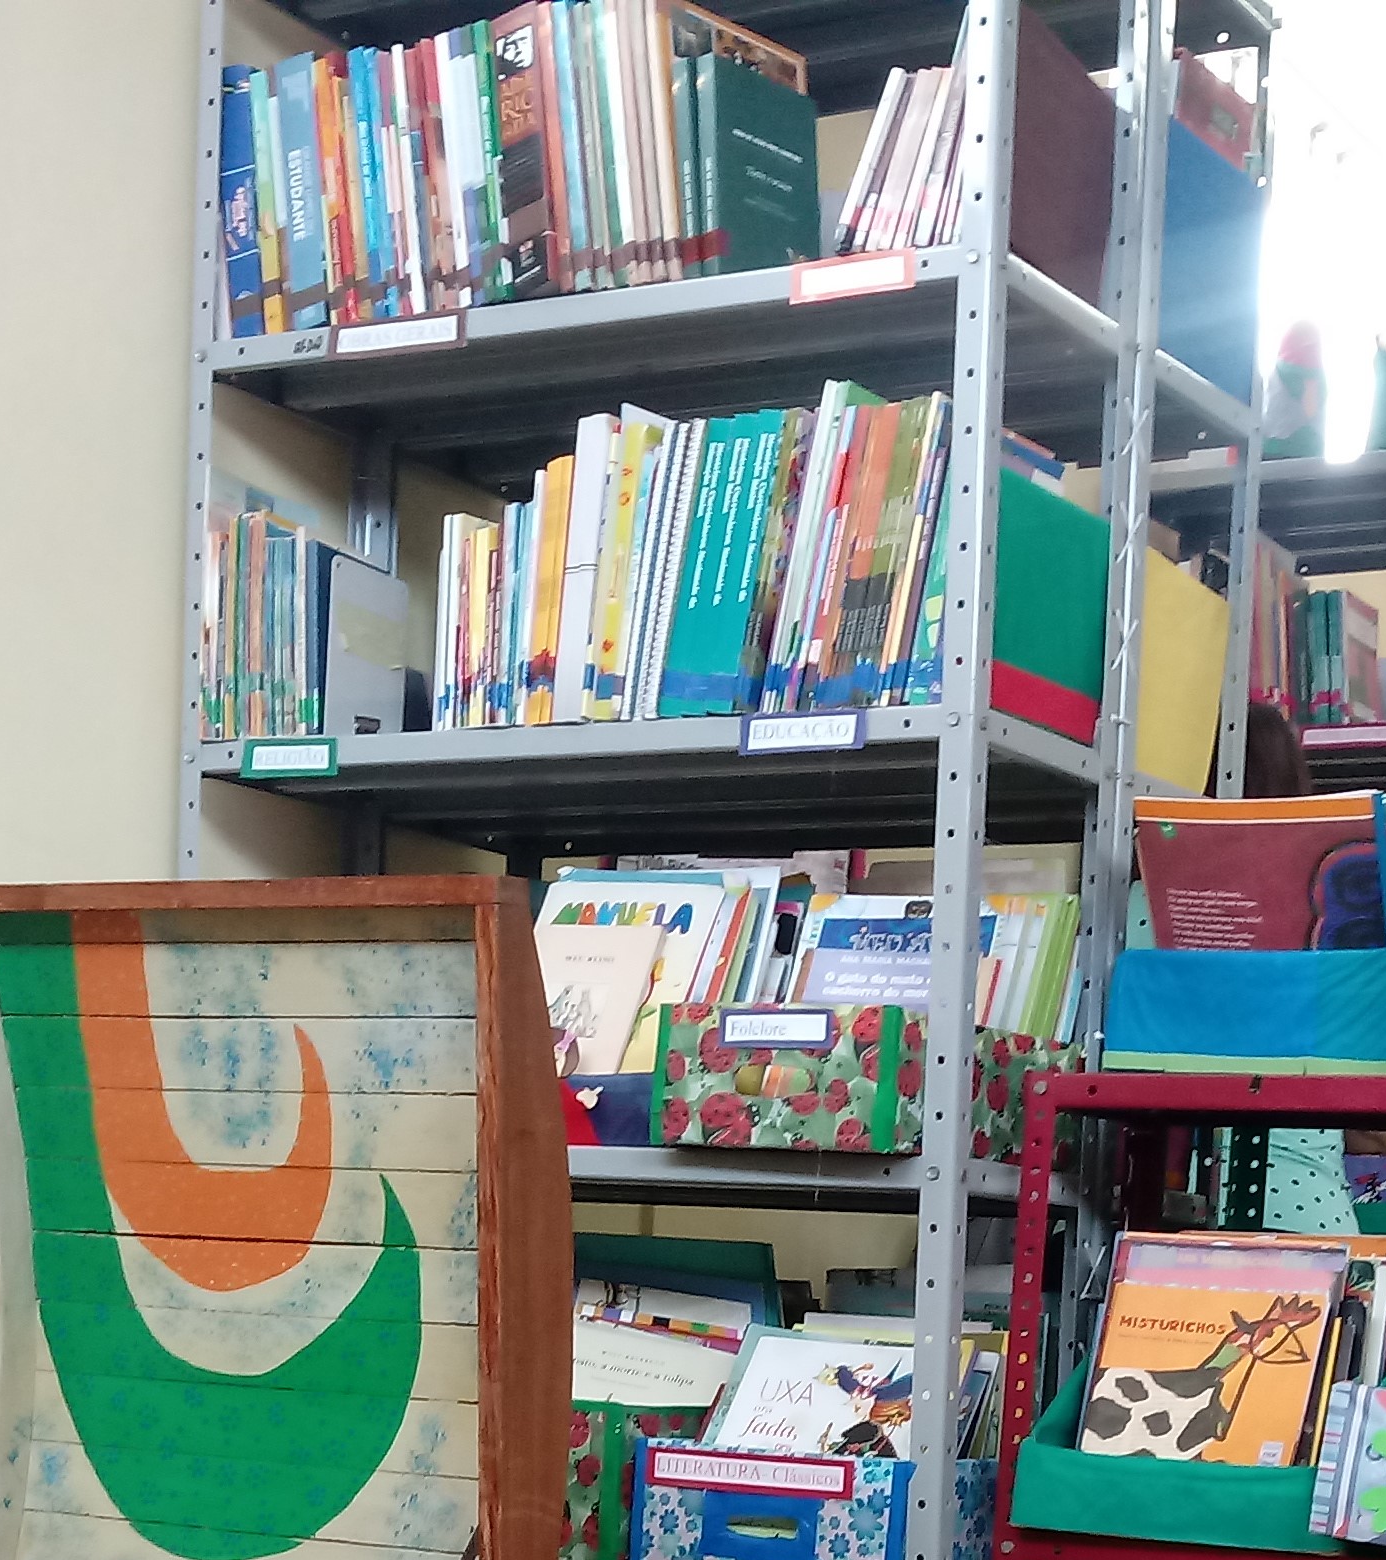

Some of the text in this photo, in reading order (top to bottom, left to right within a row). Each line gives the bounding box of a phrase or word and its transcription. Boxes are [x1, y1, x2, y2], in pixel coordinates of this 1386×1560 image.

[752, 719, 850, 742] EDUCAÇÃO
[549, 900, 694, 936] MANUELA
[730, 1019, 788, 1037] Folclore
[1118, 1314, 1228, 1336] MISTURICHOS
[759, 1377, 813, 1407] UXA
[739, 1413, 799, 1442] fada,
